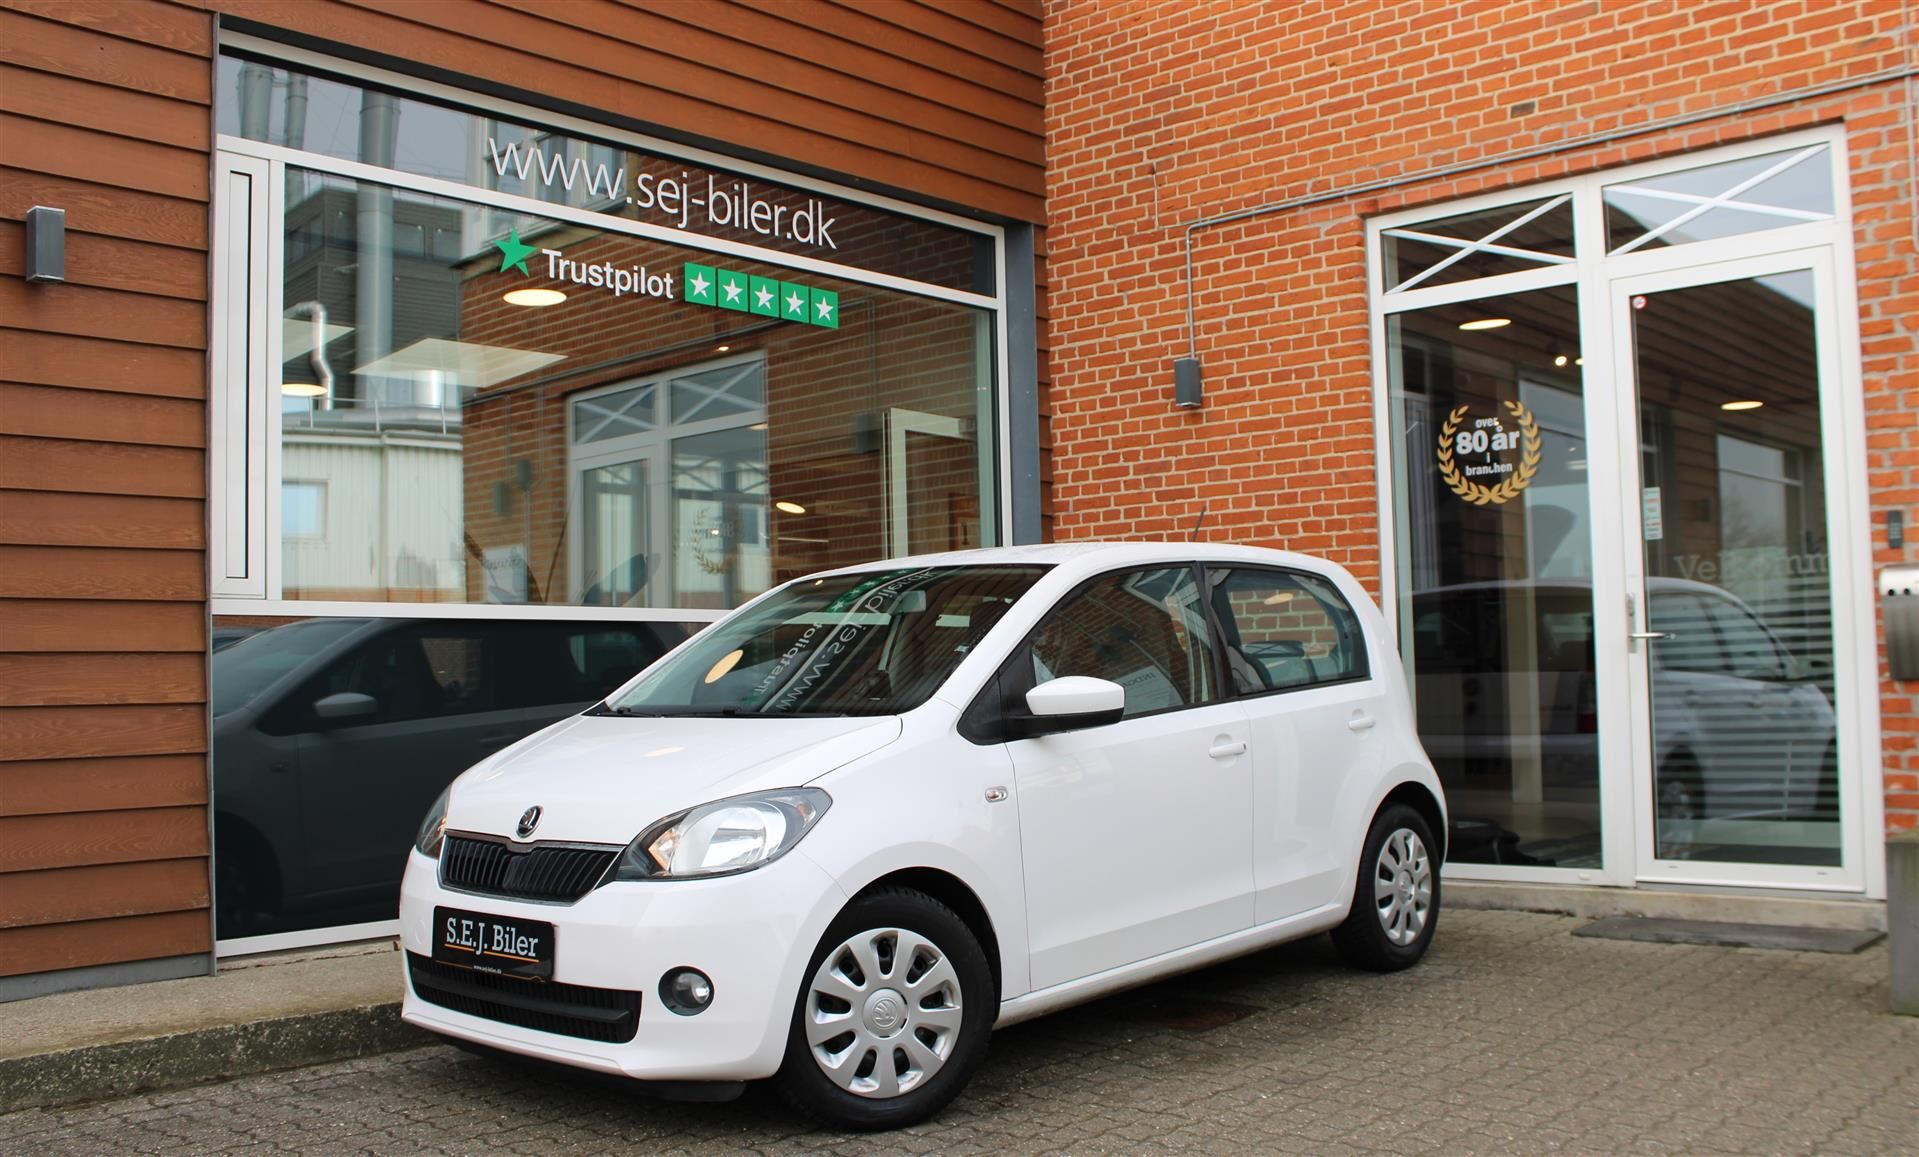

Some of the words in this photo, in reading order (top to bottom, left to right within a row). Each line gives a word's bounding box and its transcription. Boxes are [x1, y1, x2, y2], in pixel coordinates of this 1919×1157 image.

[488, 138, 837, 249] www.sej-biler.dk
[542, 248, 673, 299] Trustpilot
[1456, 429, 1488, 454] 80
[1491, 425, 1520, 451] år
[1475, 417, 1500, 429] over
[446, 917, 488, 955] S.E.J.
[491, 924, 539, 957] Biler
